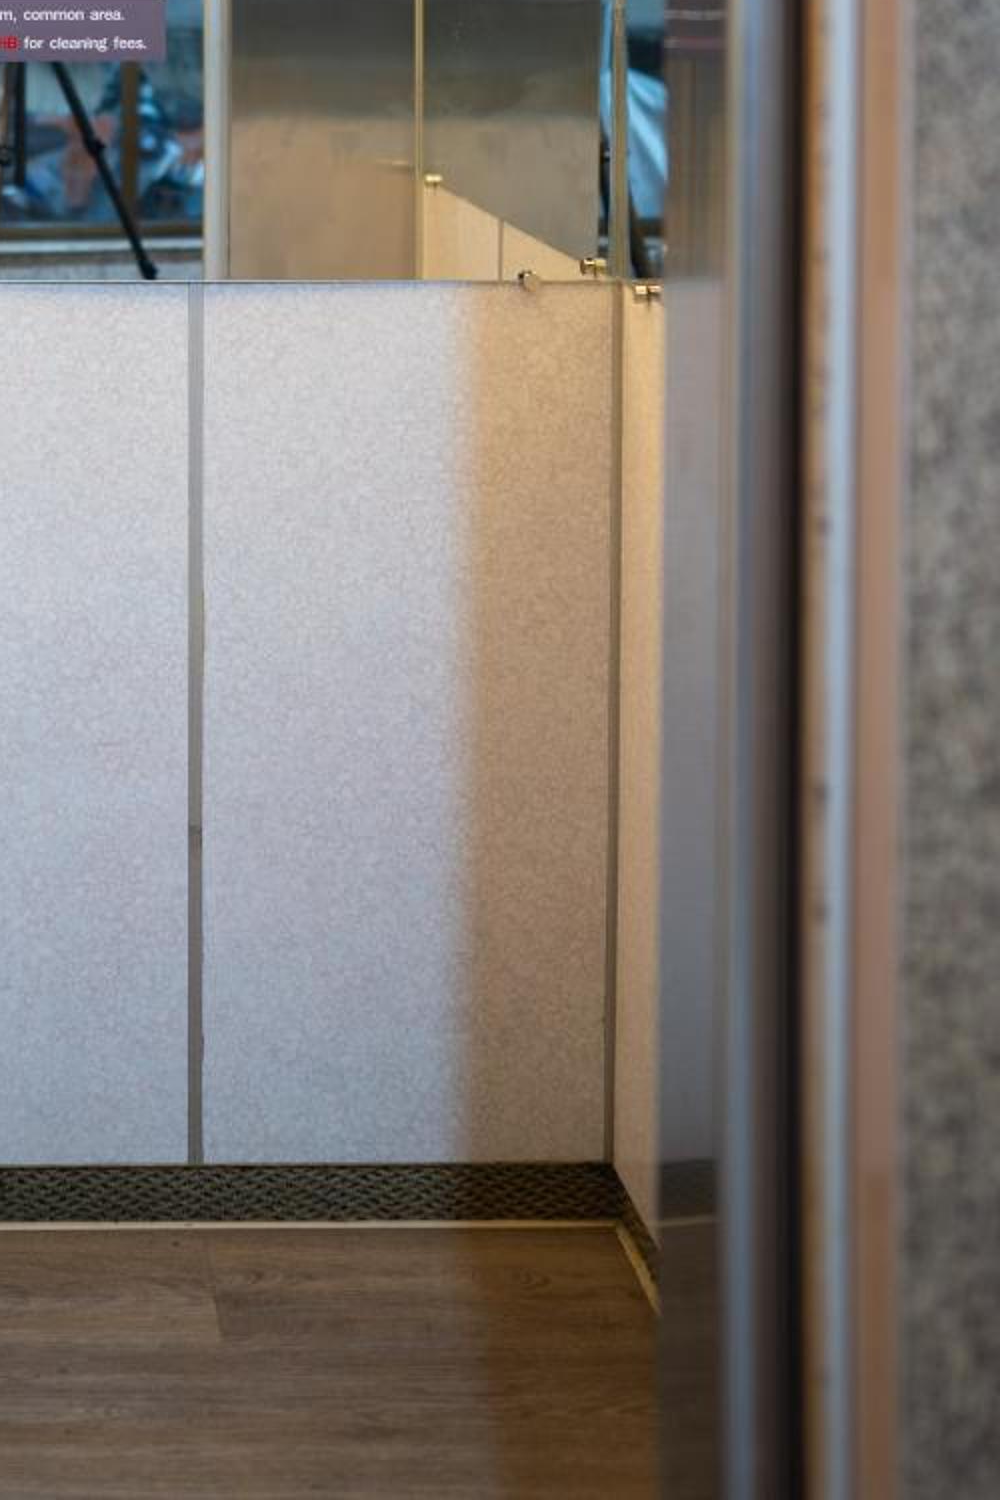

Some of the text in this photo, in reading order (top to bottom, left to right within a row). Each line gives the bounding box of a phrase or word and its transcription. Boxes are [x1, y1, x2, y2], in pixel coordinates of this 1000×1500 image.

[23, 9, 85, 21] common
[89, 9, 125, 21] area.
[24, 35, 44, 50] for
[49, 36, 108, 53] cleaning
[113, 35, 147, 50] fees.
